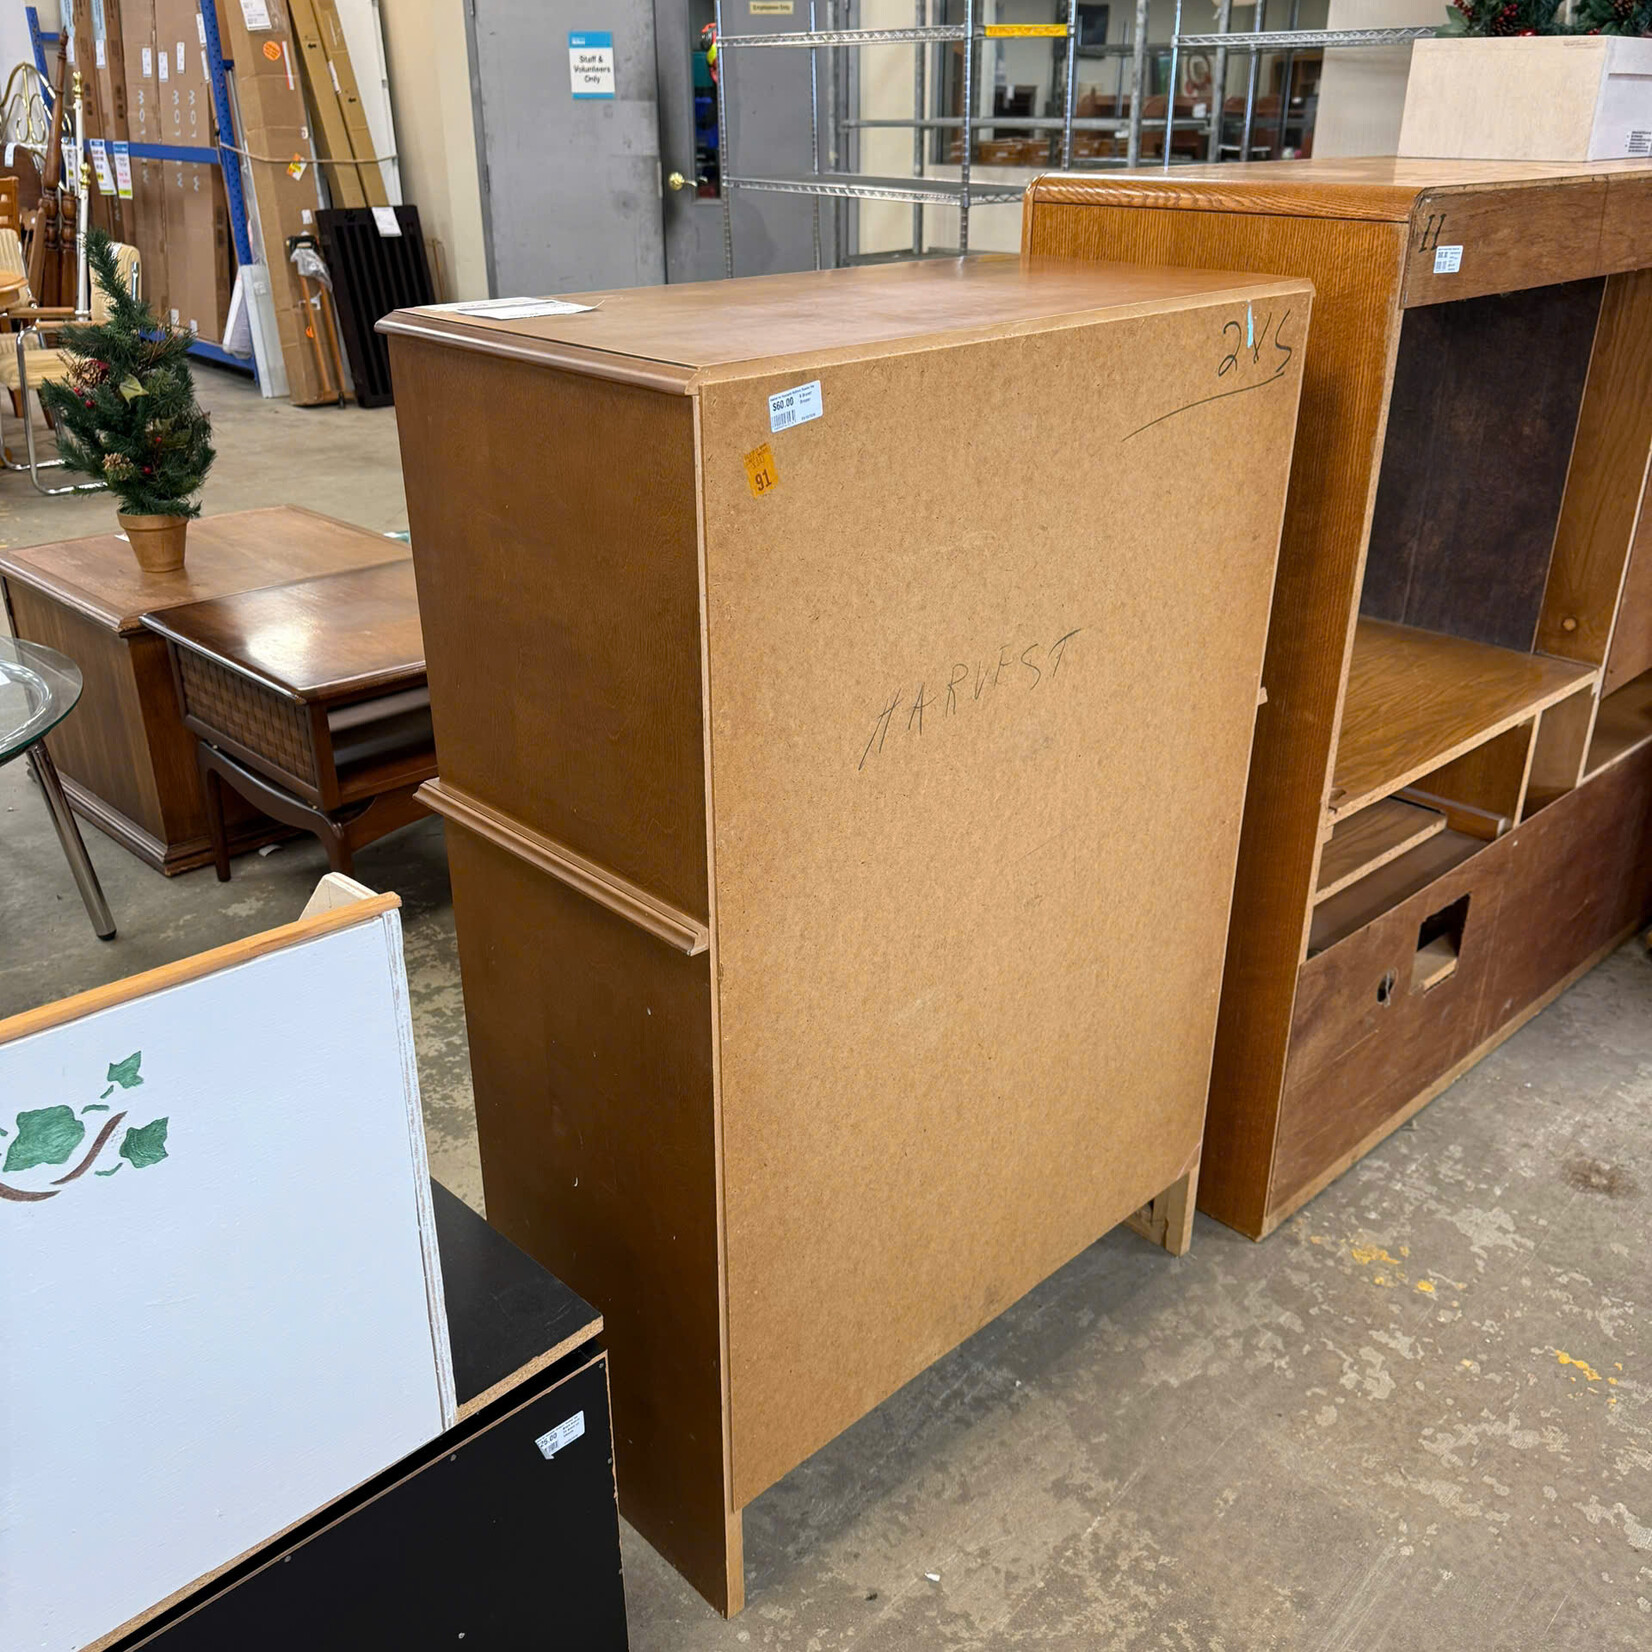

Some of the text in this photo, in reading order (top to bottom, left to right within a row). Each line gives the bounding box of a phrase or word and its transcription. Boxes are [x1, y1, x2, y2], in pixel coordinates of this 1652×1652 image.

[579, 55, 603, 63] Staff &
[573, 65, 611, 73] Volunteers
[584, 75, 601, 84] Only
[772, 396, 795, 412] $60.00
[754, 468, 772, 492] 91
[858, 628, 1082, 771] HARVEST
